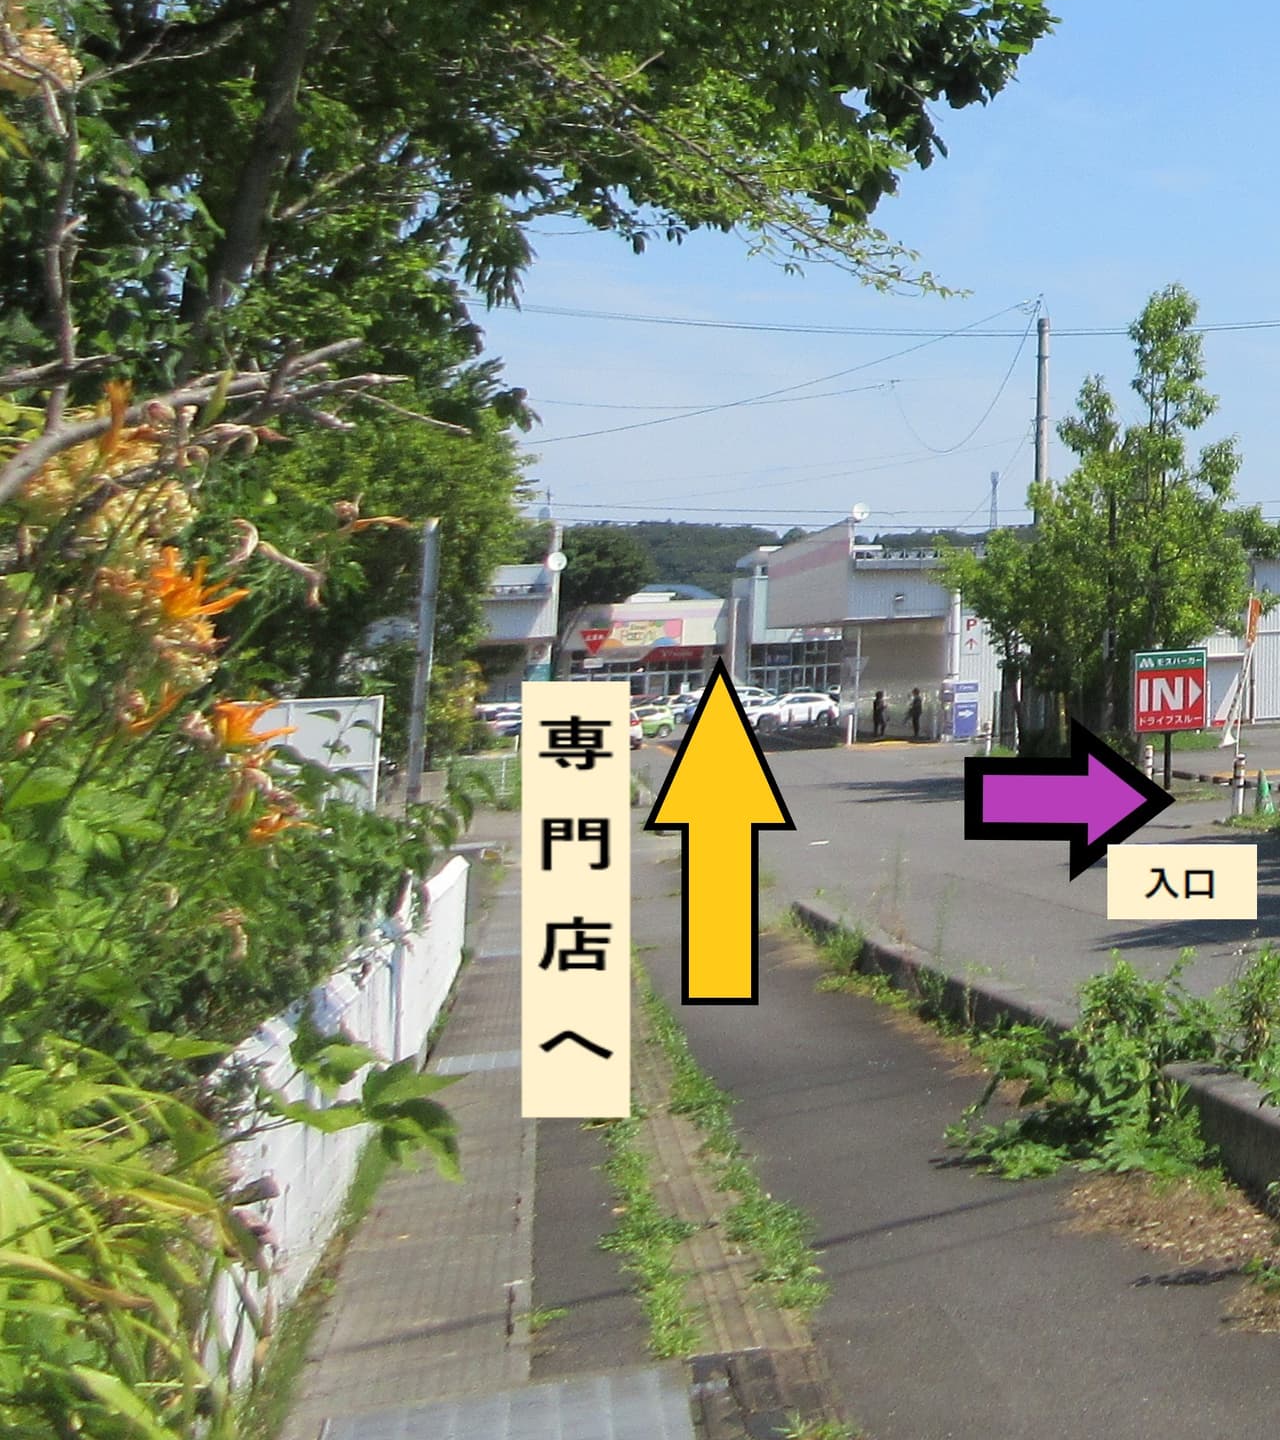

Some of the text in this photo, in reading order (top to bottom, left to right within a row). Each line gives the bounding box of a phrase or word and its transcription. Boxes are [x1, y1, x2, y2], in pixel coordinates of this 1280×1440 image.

[966, 619, 977, 631] P
[1157, 656, 1202, 666] モスバーガー
[1139, 676, 1184, 712] IN
[1140, 715, 1202, 726] ドライブスルー
